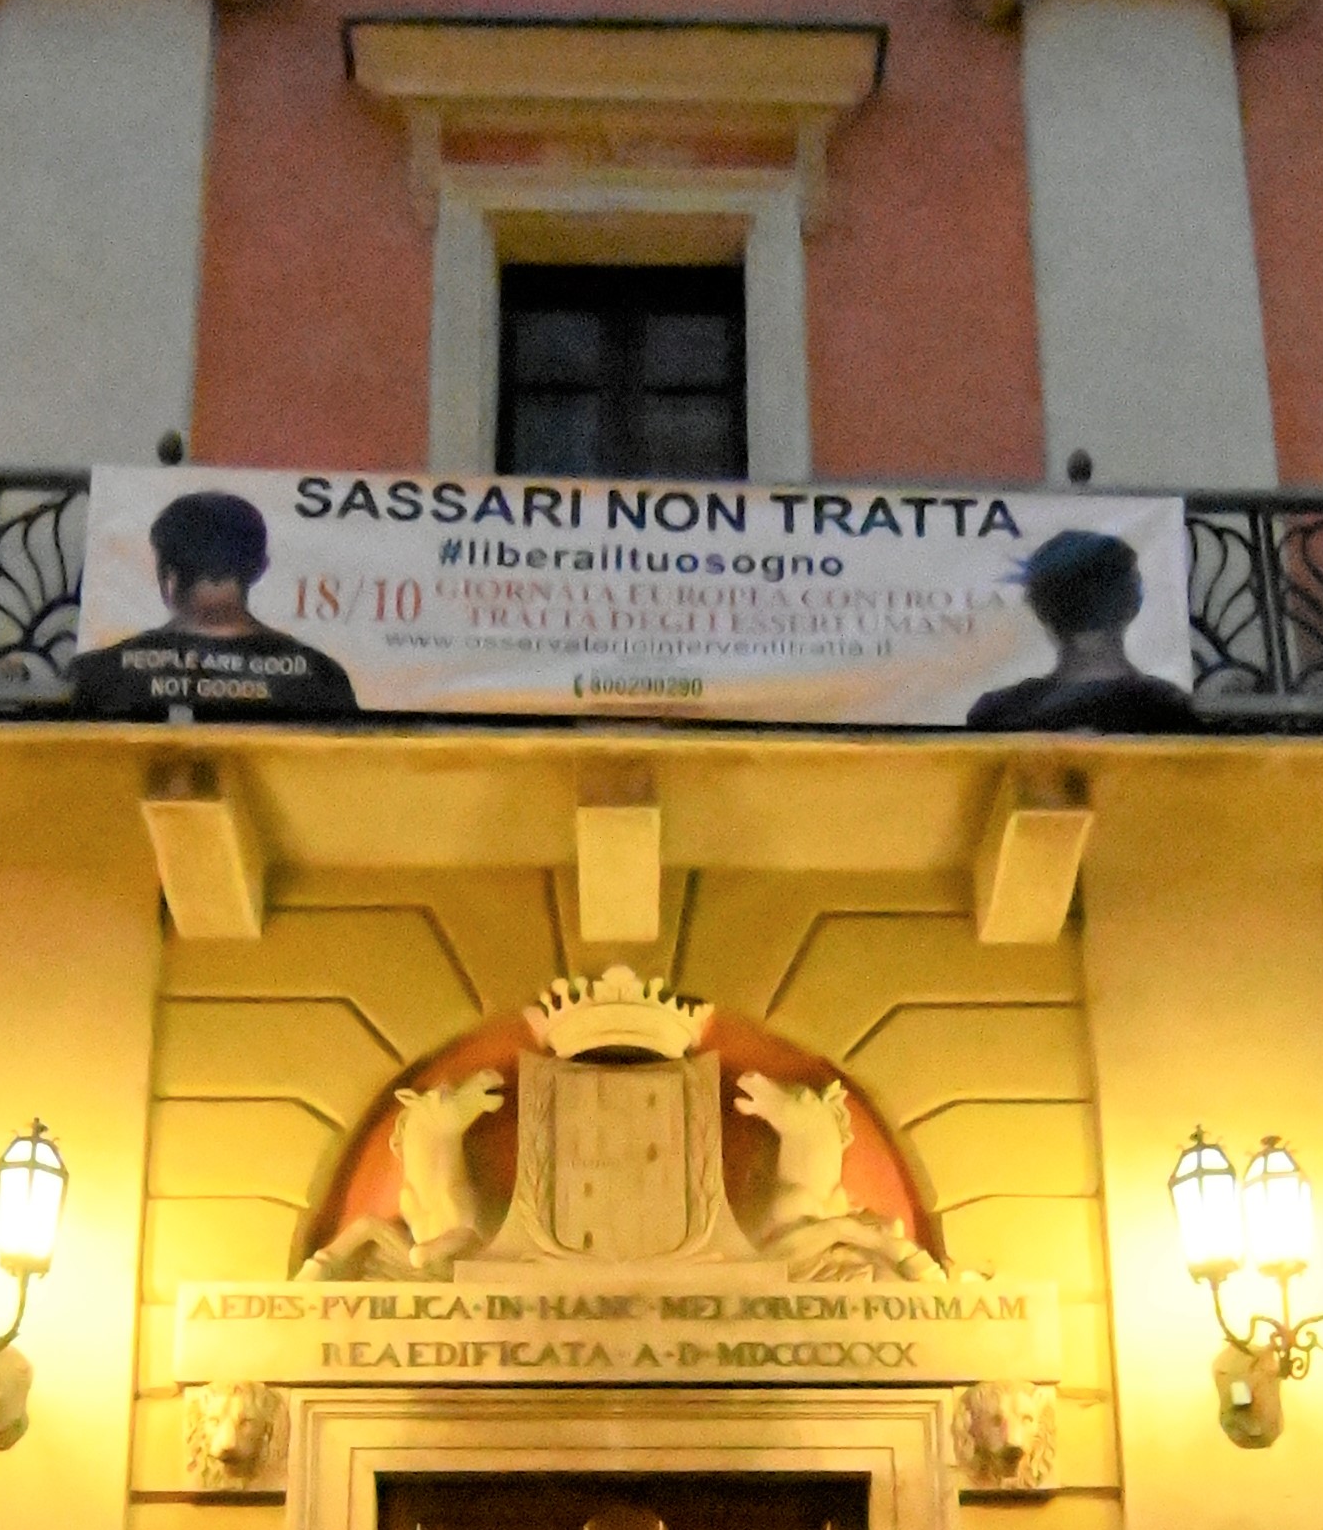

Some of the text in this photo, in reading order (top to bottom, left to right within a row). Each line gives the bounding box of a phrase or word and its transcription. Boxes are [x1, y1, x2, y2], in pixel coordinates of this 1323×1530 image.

[295, 477, 1022, 541] SASSARI NON TRATTA
[437, 537, 846, 583] #liberailtuosogno
[290, 575, 423, 625] 18/10
[151, 675, 194, 699] NOT
[190, 1293, 306, 1321] AEDES
[863, 1294, 1028, 1321] FORMAM
[322, 1340, 614, 1369] REAEDIFICATA
